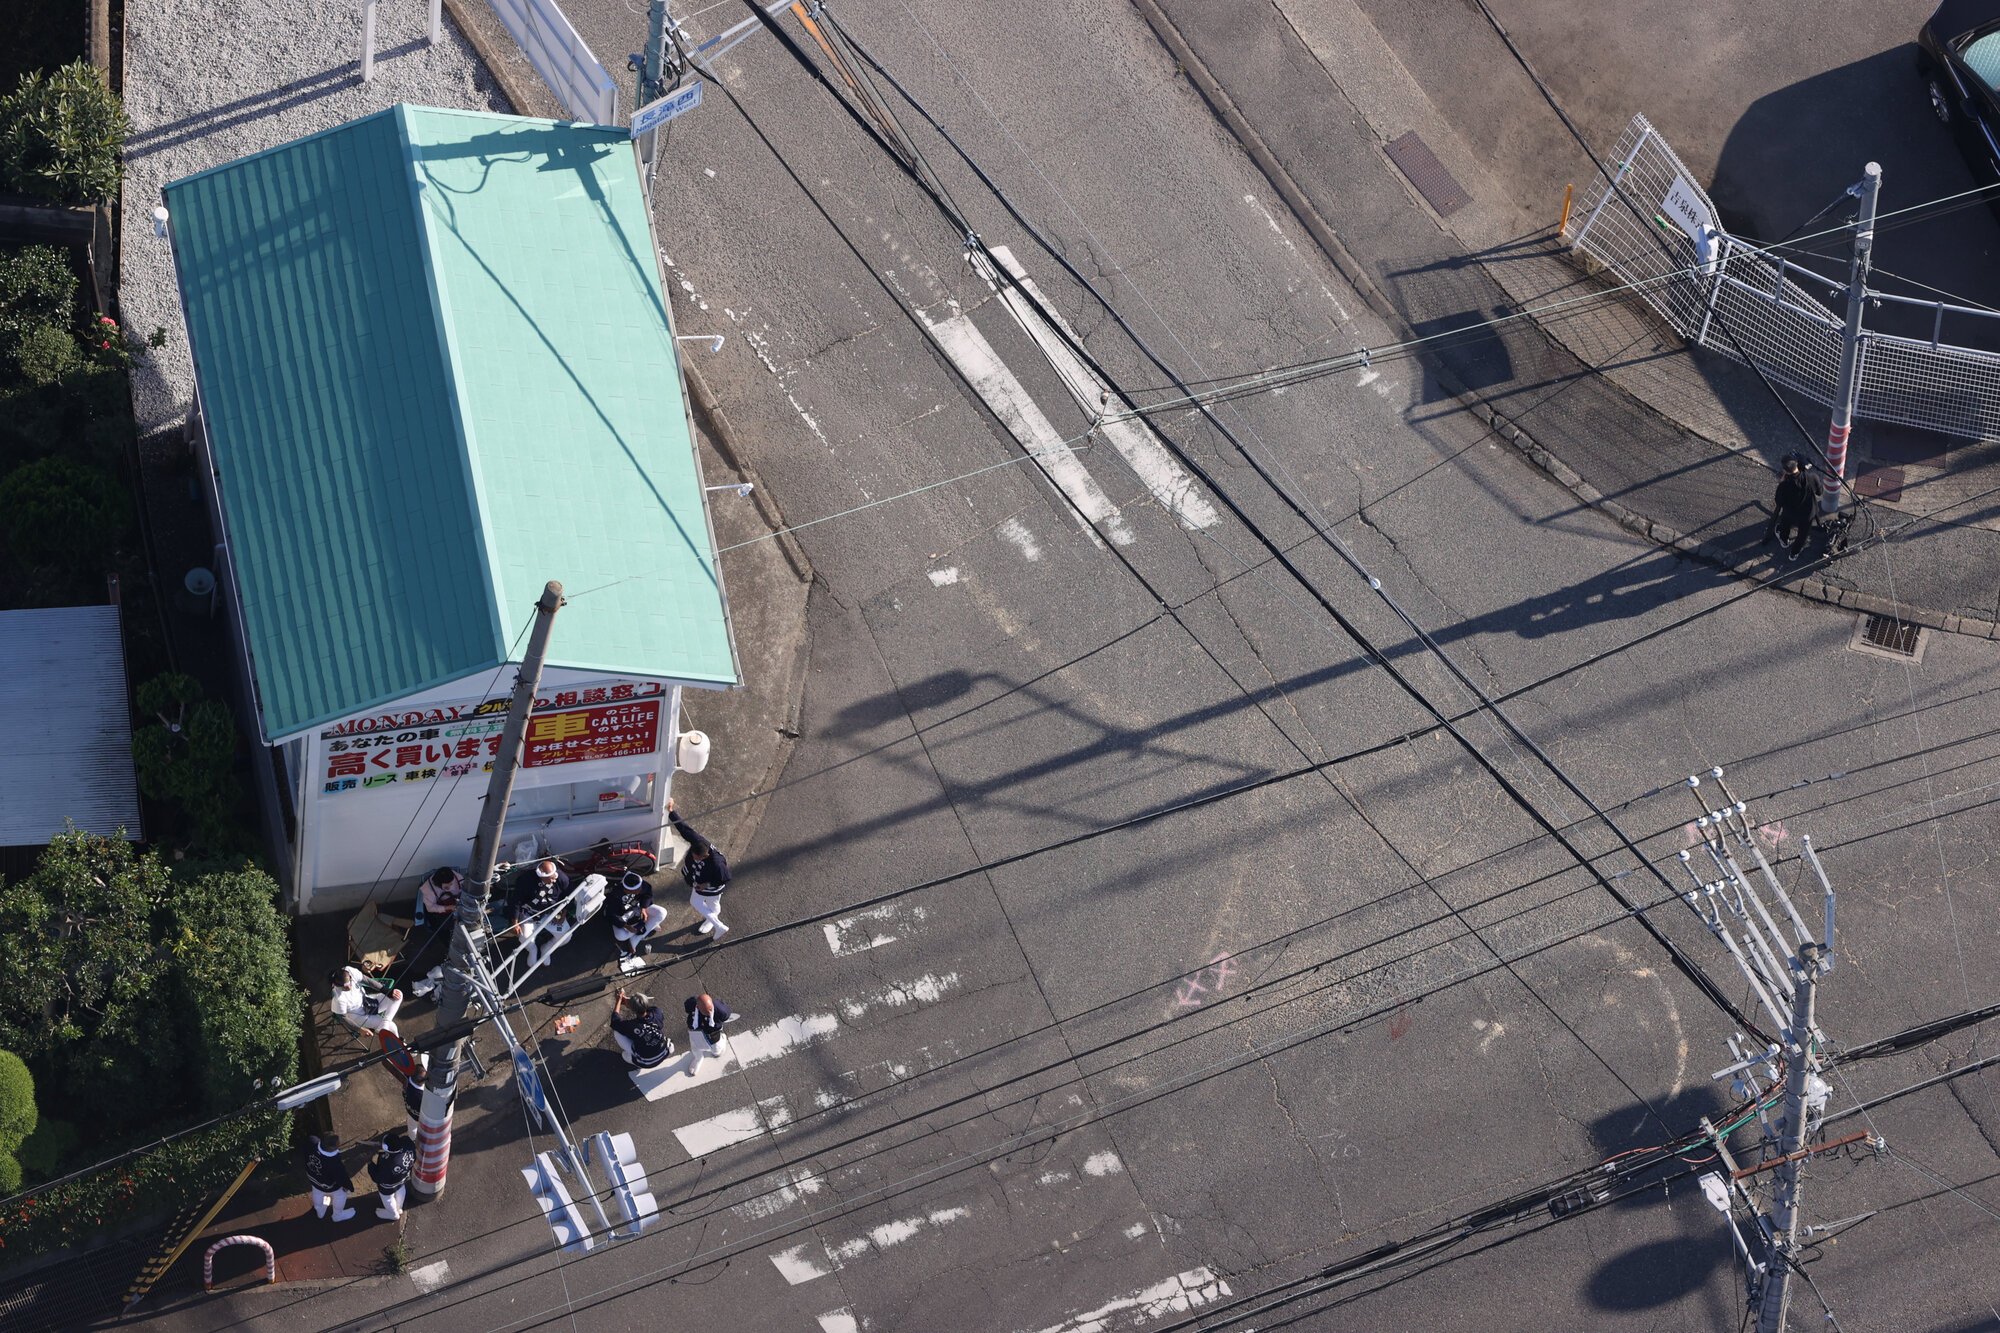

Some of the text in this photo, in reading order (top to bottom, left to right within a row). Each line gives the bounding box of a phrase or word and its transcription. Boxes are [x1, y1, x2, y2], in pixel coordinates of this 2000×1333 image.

[328, 704, 468, 736] MONDAY
[591, 711, 655, 727] CAR LIFE
[606, 706, 641, 716] のこと
[529, 713, 590, 742] 車
[598, 721, 647, 733] のすべて
[329, 729, 440, 752] あなたの車
[328, 734, 503, 778] 高く買います
[325, 768, 437, 792] 販売 リース 車検
